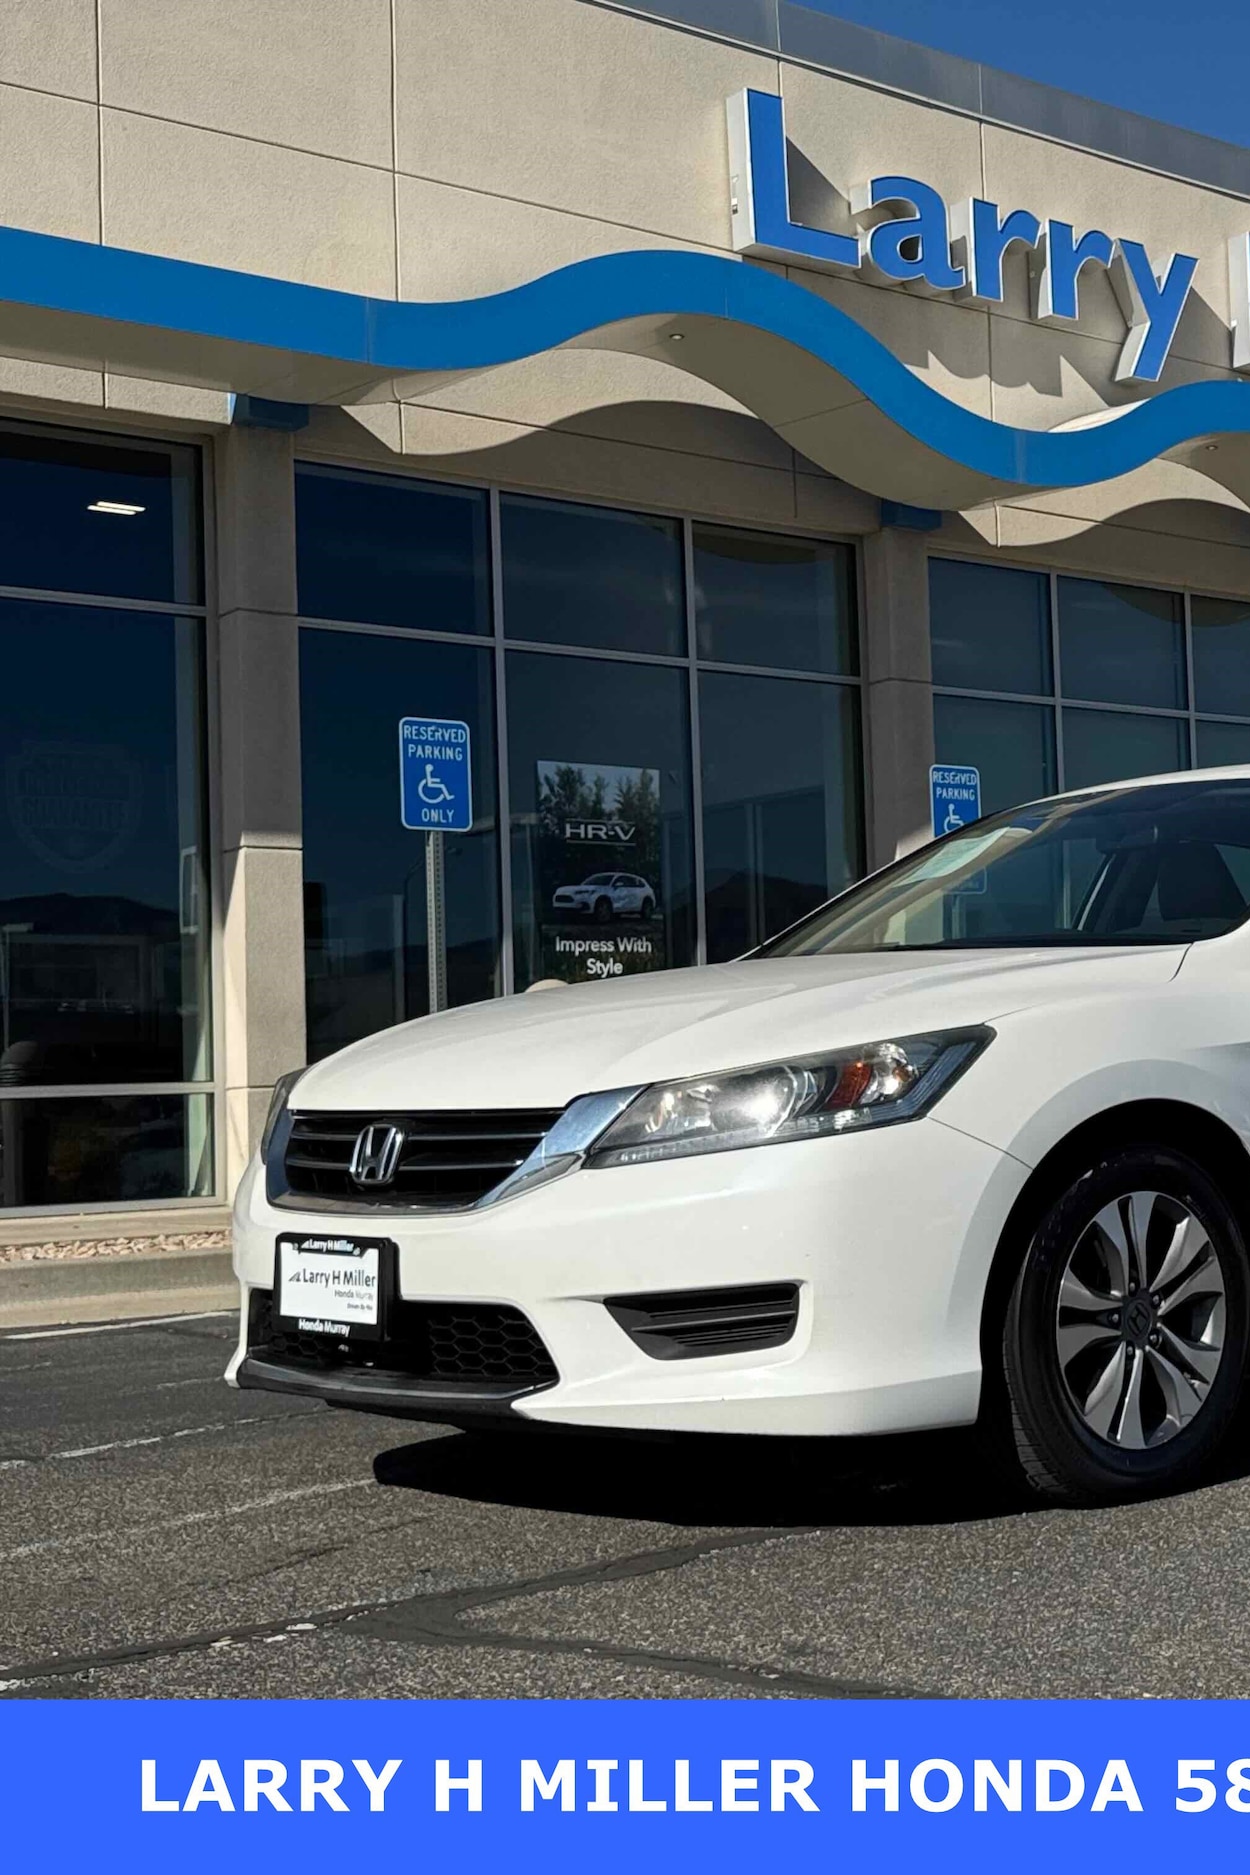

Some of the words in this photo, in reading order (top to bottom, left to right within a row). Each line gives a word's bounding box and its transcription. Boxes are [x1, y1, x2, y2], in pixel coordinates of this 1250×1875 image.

[740, 88, 1198, 384] Larry
[403, 725, 466, 743] RESERVED
[408, 744, 463, 761] PARKING
[933, 771, 977, 785] RESERVED
[936, 787, 976, 801] PARKING
[421, 808, 455, 823] ONLY
[565, 823, 636, 841] HR-V
[555, 936, 615, 957] Impress
[616, 936, 652, 953] With
[586, 957, 624, 979] Style
[309, 1239, 328, 1252] Larry
[303, 1268, 331, 1288] Larry
[332, 1270, 341, 1285] H
[343, 1269, 376, 1287] Miller
[298, 1318, 324, 1333] Honda
[324, 1320, 351, 1337] Murray
